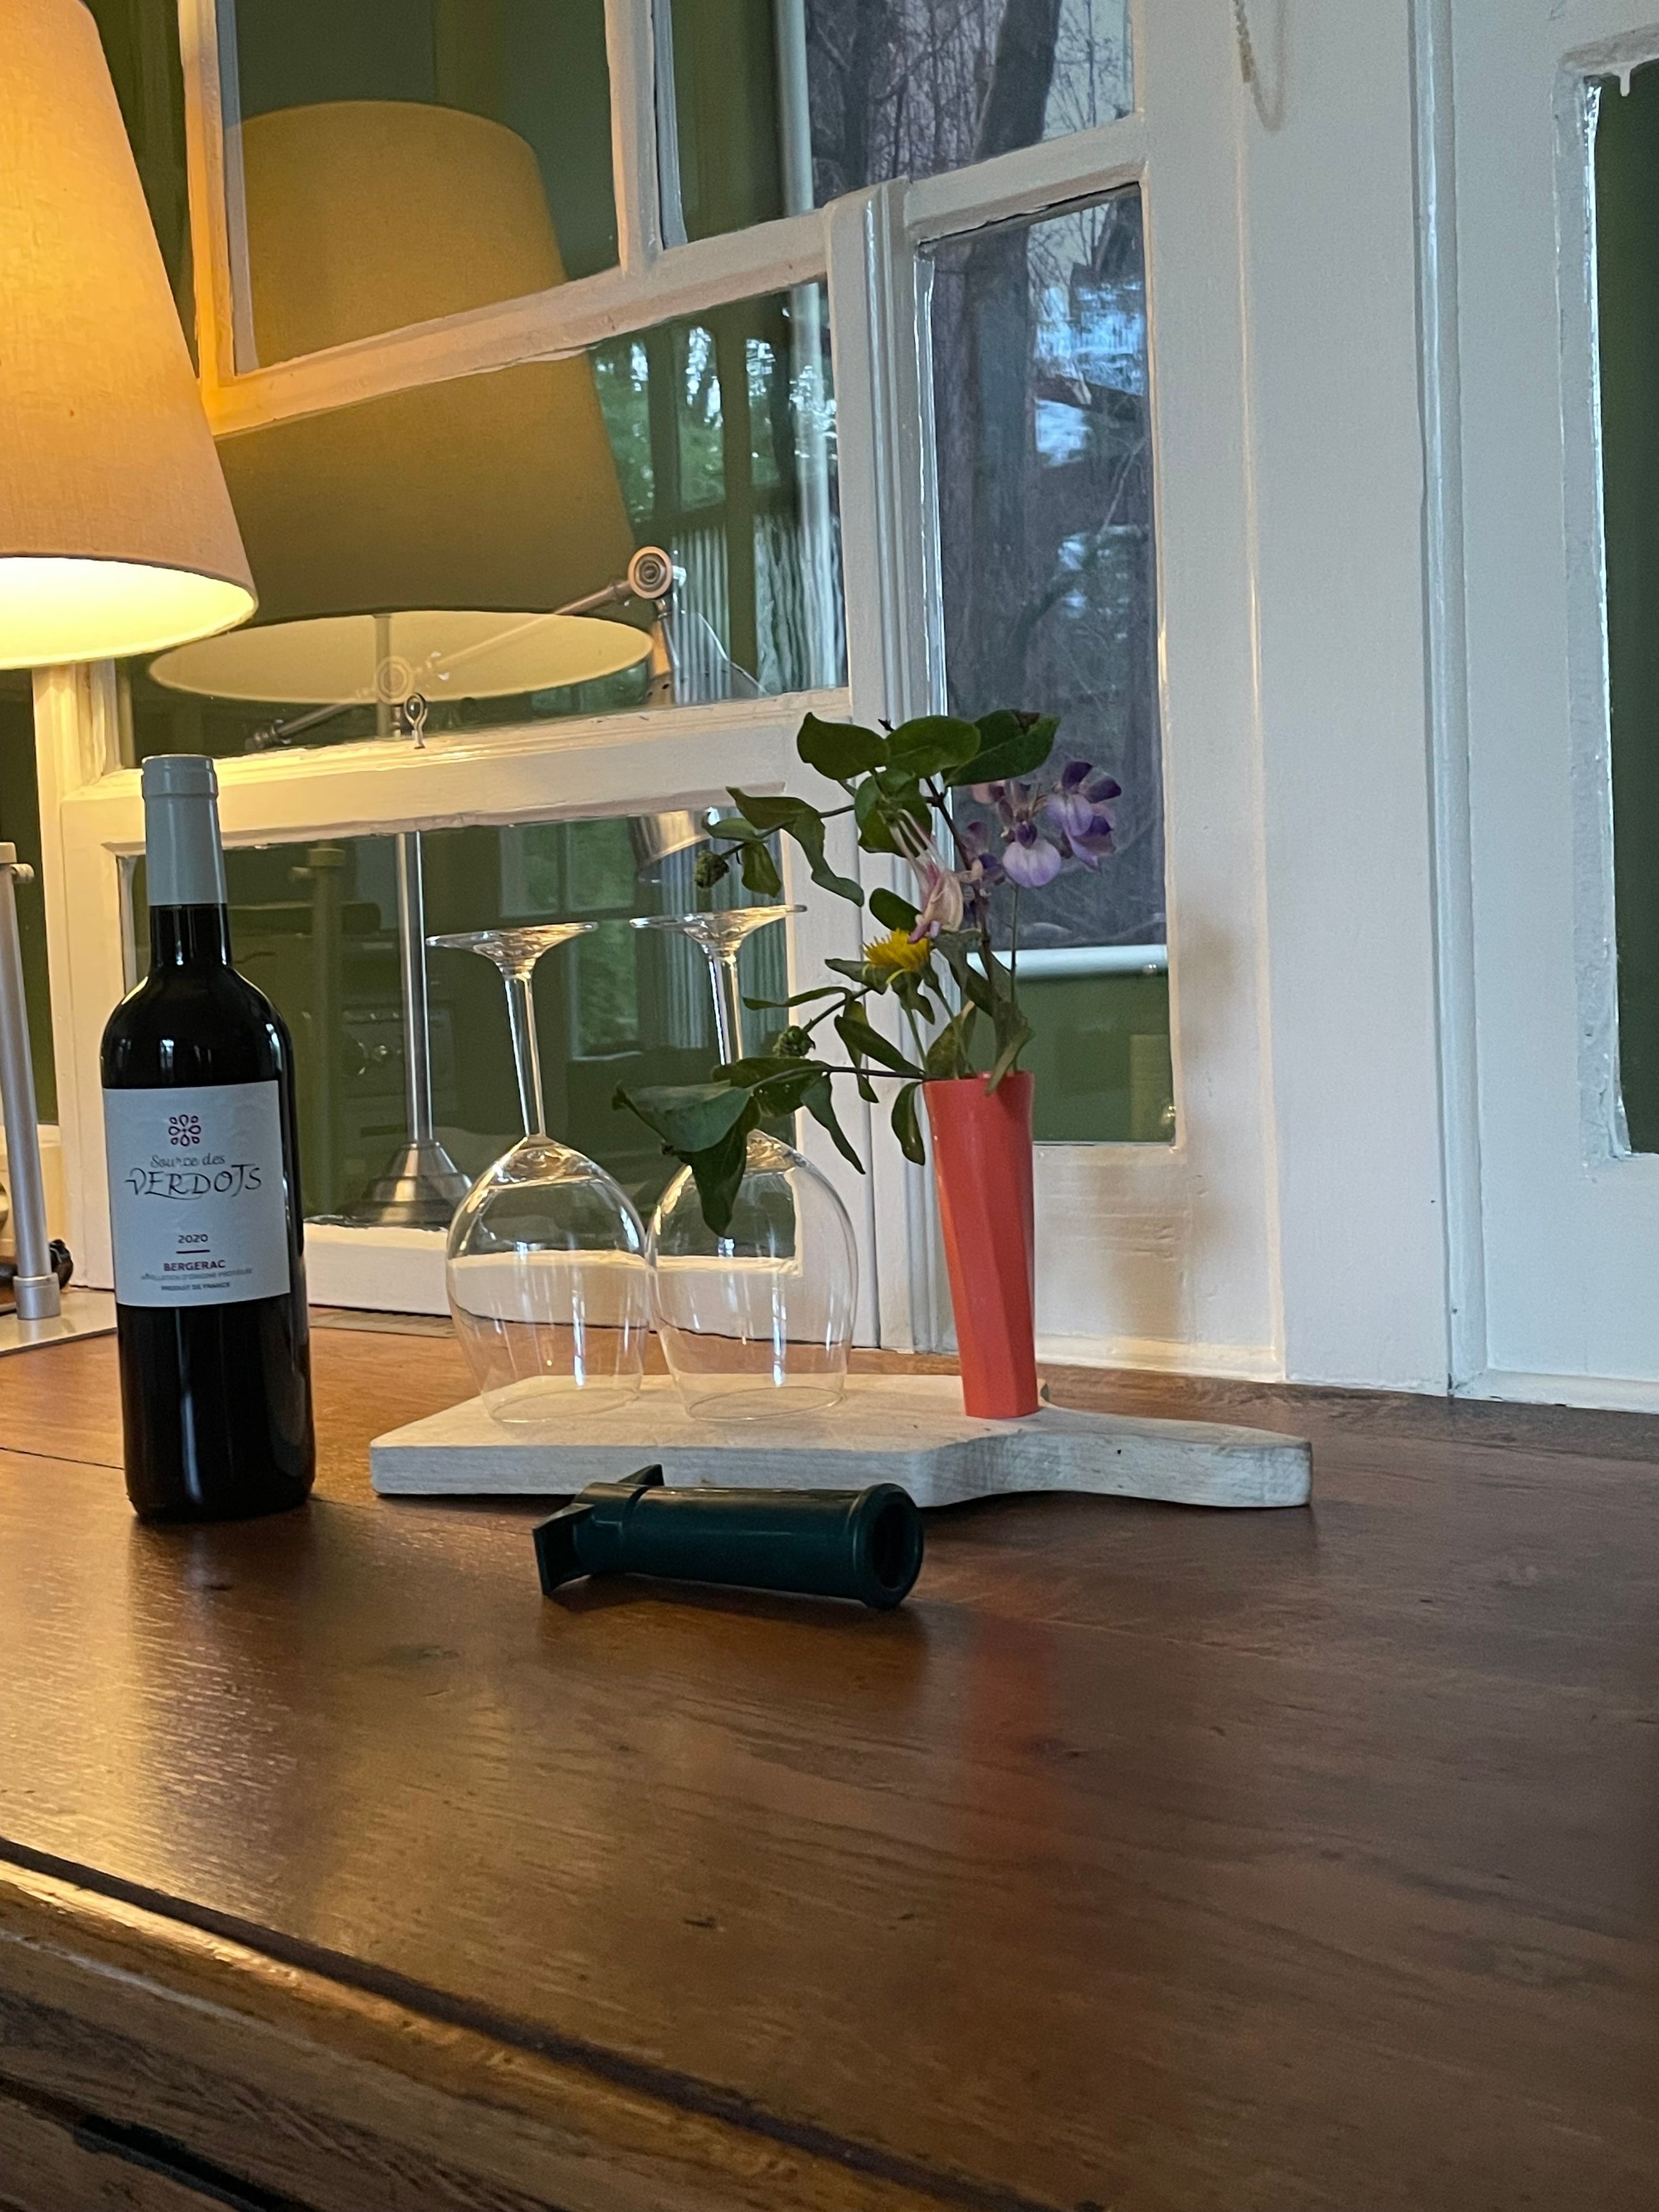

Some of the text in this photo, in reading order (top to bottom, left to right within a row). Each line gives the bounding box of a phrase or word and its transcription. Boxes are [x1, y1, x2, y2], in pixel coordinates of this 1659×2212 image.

[150, 1153, 225, 1168] Source des
[124, 1163, 262, 1200] VERDOTS
[177, 1233, 209, 1244] 2020
[163, 1259, 226, 1271] BERGERAC
